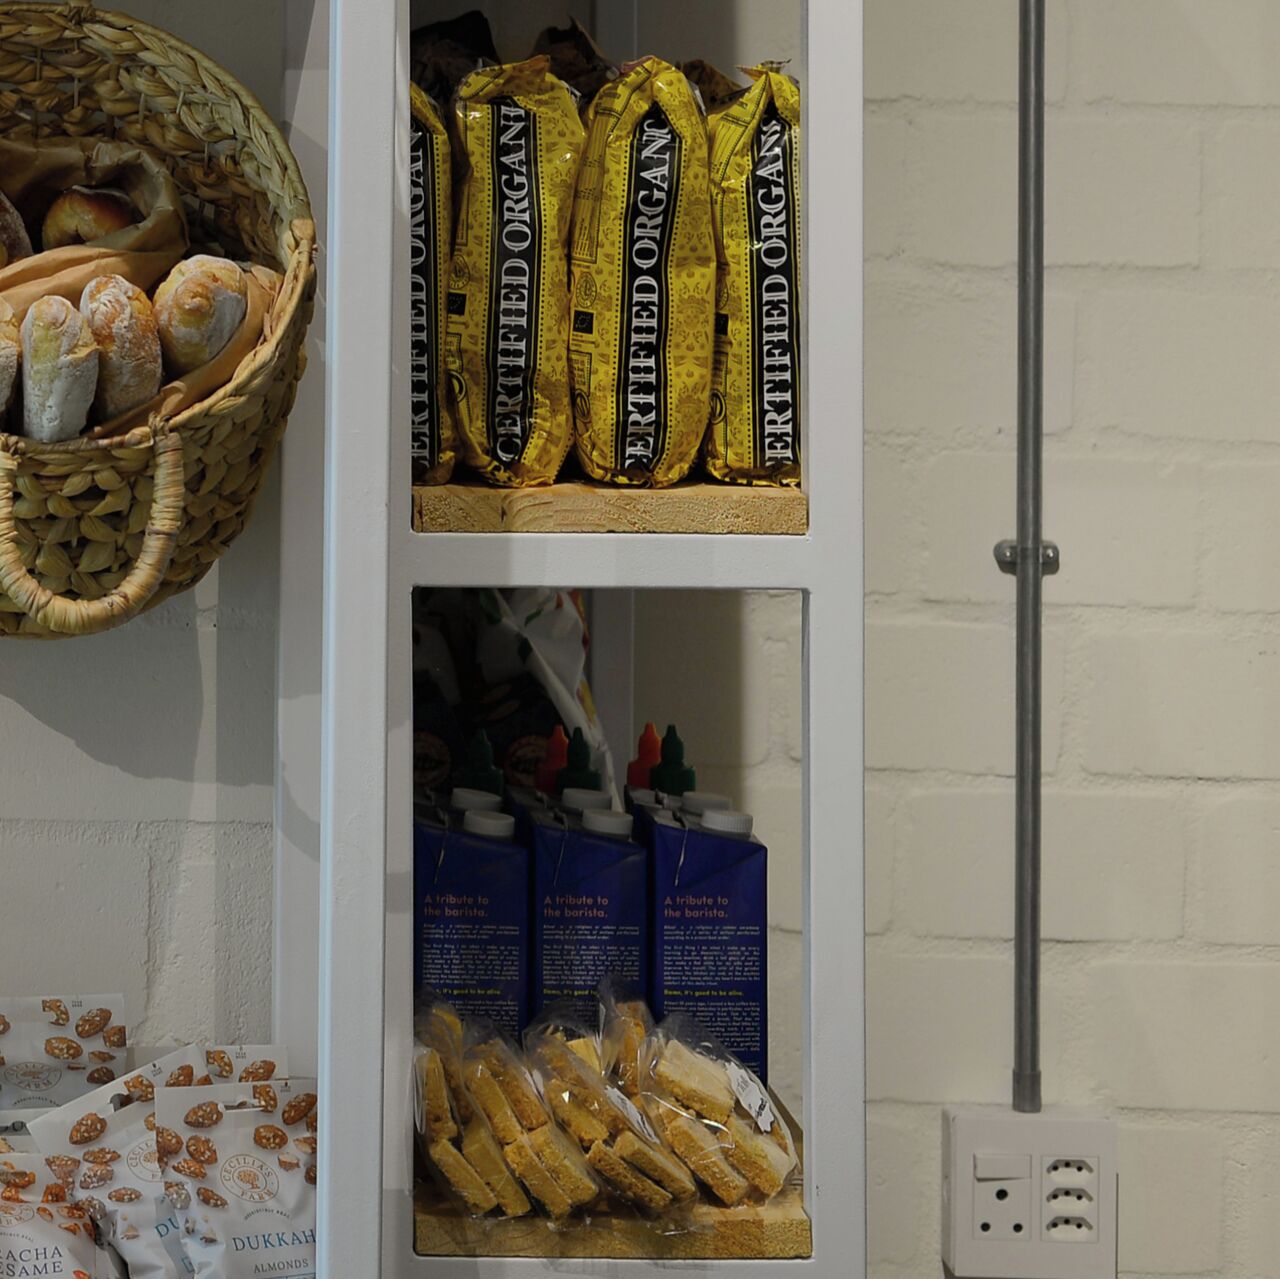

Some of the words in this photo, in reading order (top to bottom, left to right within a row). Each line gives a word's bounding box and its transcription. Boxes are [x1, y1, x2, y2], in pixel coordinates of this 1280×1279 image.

[496, 258, 530, 462] CERTIFIED
[676, 896, 714, 905] tribute
[718, 896, 729, 905] to
[664, 907, 681, 917] the
[685, 907, 728, 918] barista.
[232, 1229, 316, 1252] DUKKAH
[254, 1258, 309, 1273] ALMONDS
